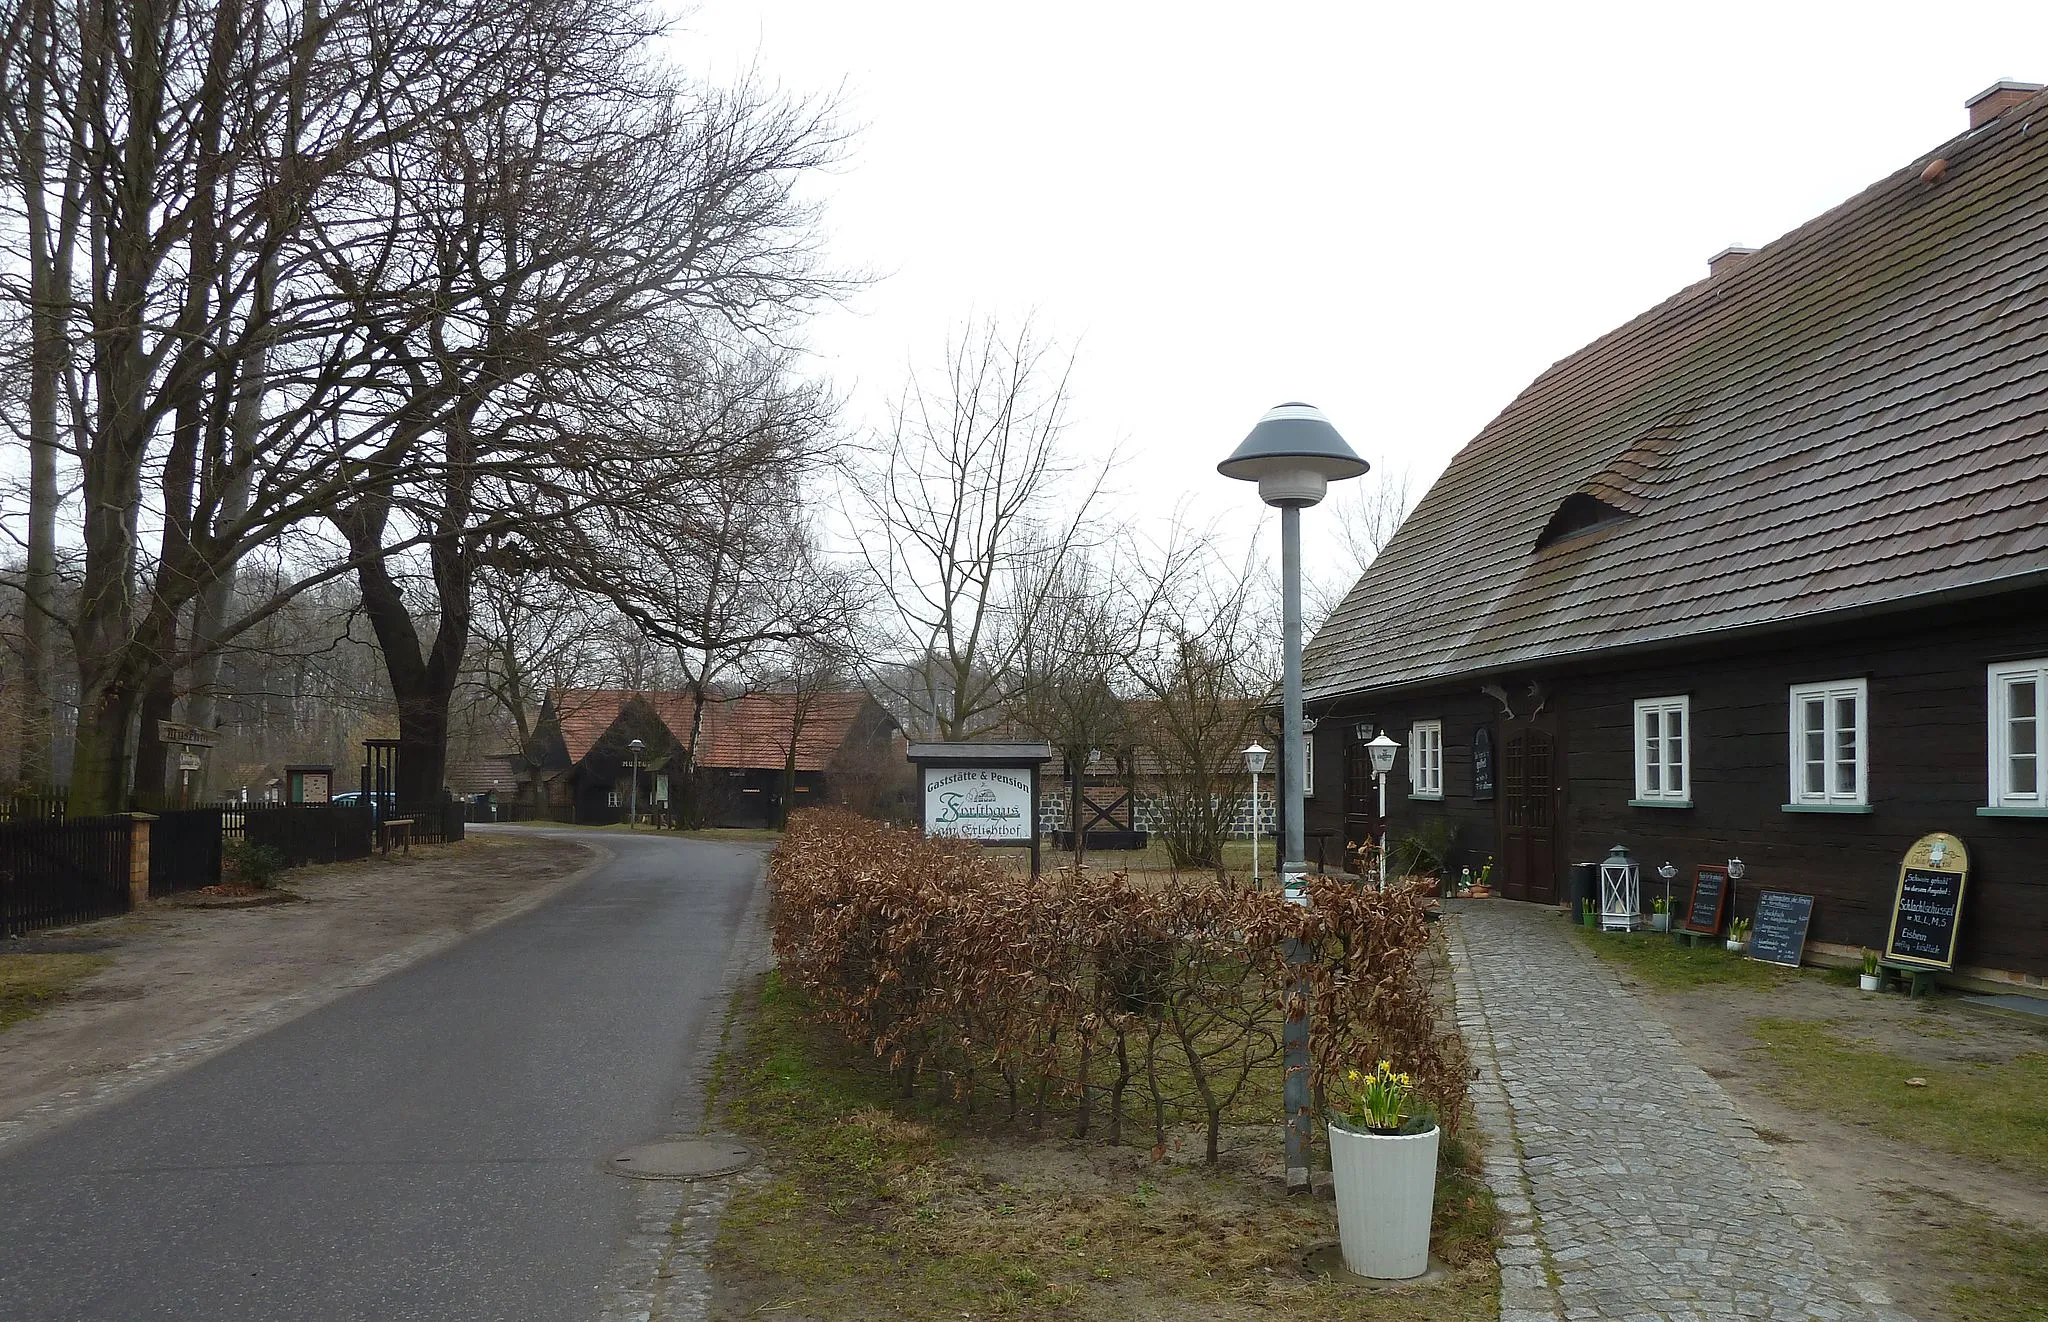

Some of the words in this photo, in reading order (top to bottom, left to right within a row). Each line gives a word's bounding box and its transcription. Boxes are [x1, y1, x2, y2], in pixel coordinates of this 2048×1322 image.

[927, 772, 977, 793] Gaststätte
[980, 771, 988, 781] &
[991, 771, 1030, 794] Pension
